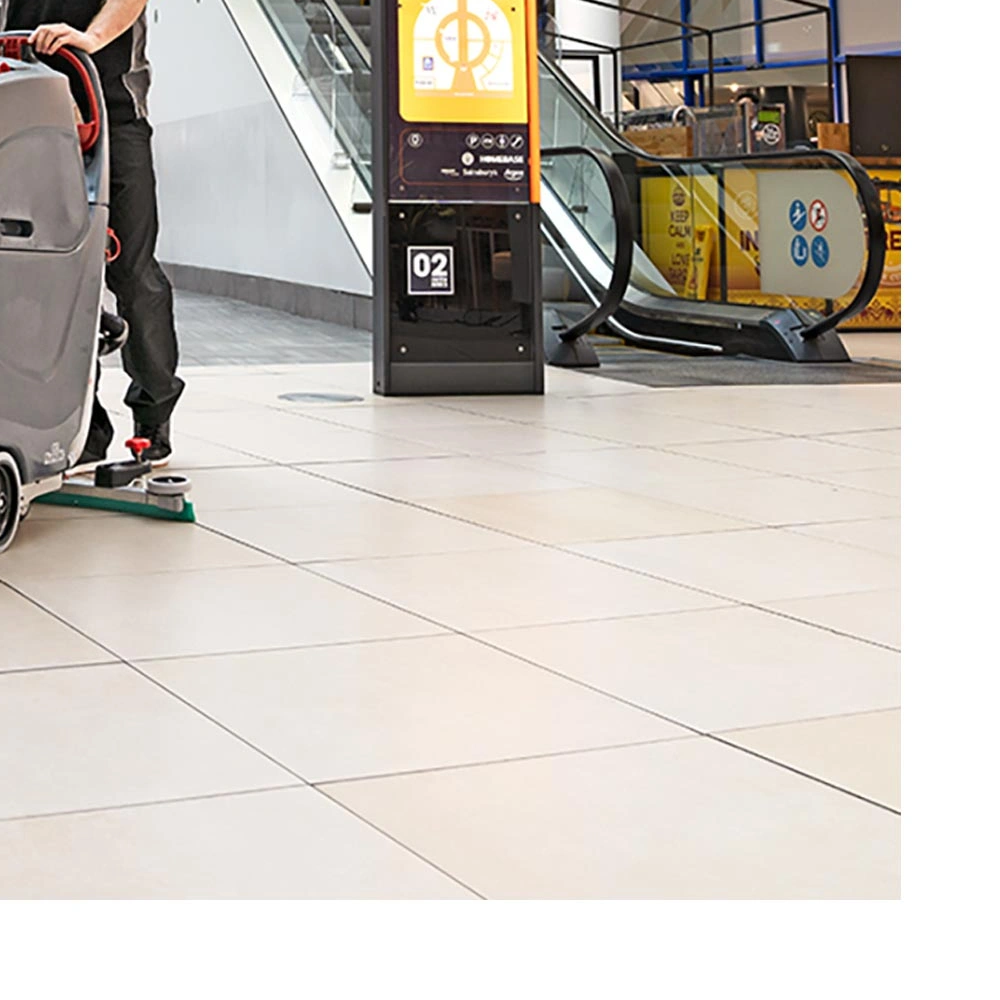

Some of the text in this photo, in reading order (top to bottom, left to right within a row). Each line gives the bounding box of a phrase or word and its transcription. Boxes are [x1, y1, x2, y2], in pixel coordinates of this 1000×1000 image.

[671, 209, 690, 223] KEEP
[668, 224, 692, 238] CALM
[413, 252, 448, 278] 02
